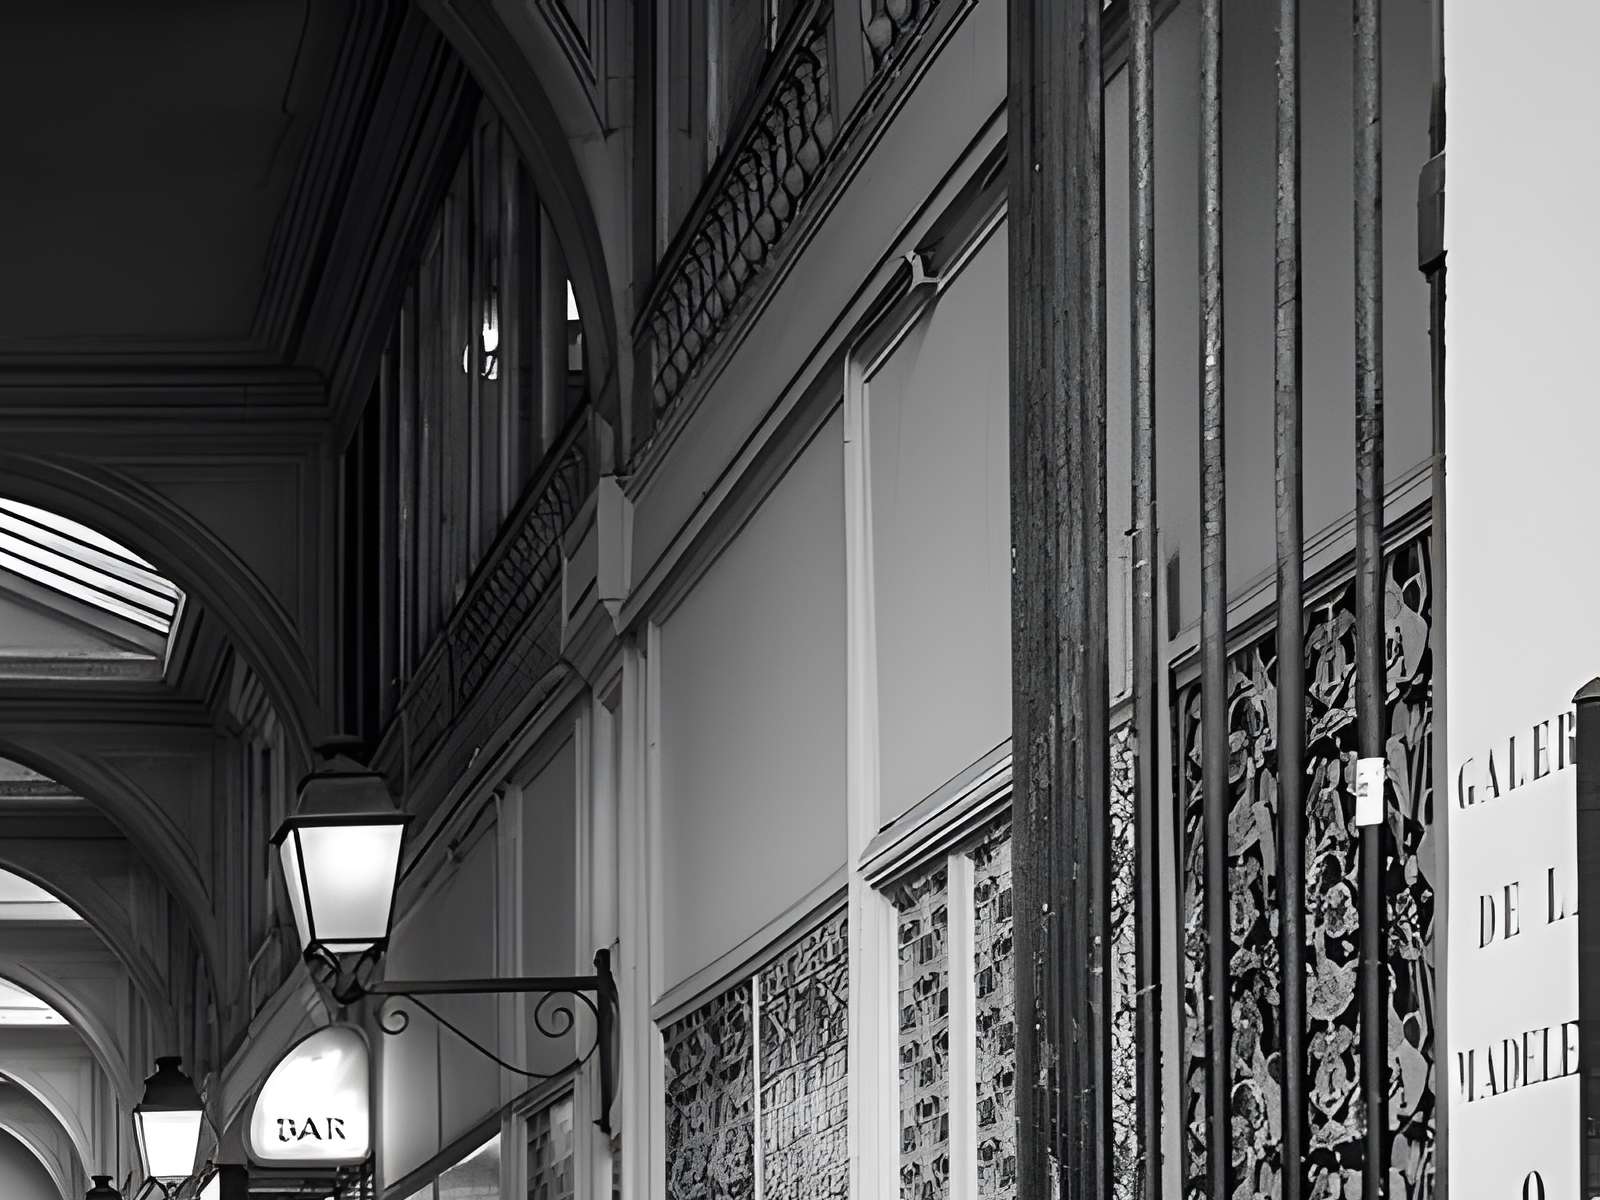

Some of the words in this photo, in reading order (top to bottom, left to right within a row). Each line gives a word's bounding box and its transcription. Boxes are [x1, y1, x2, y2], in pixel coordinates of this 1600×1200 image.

[1479, 893, 1520, 949] DE
[1546, 867, 1579, 925] L
[276, 1116, 346, 1142] BAR
